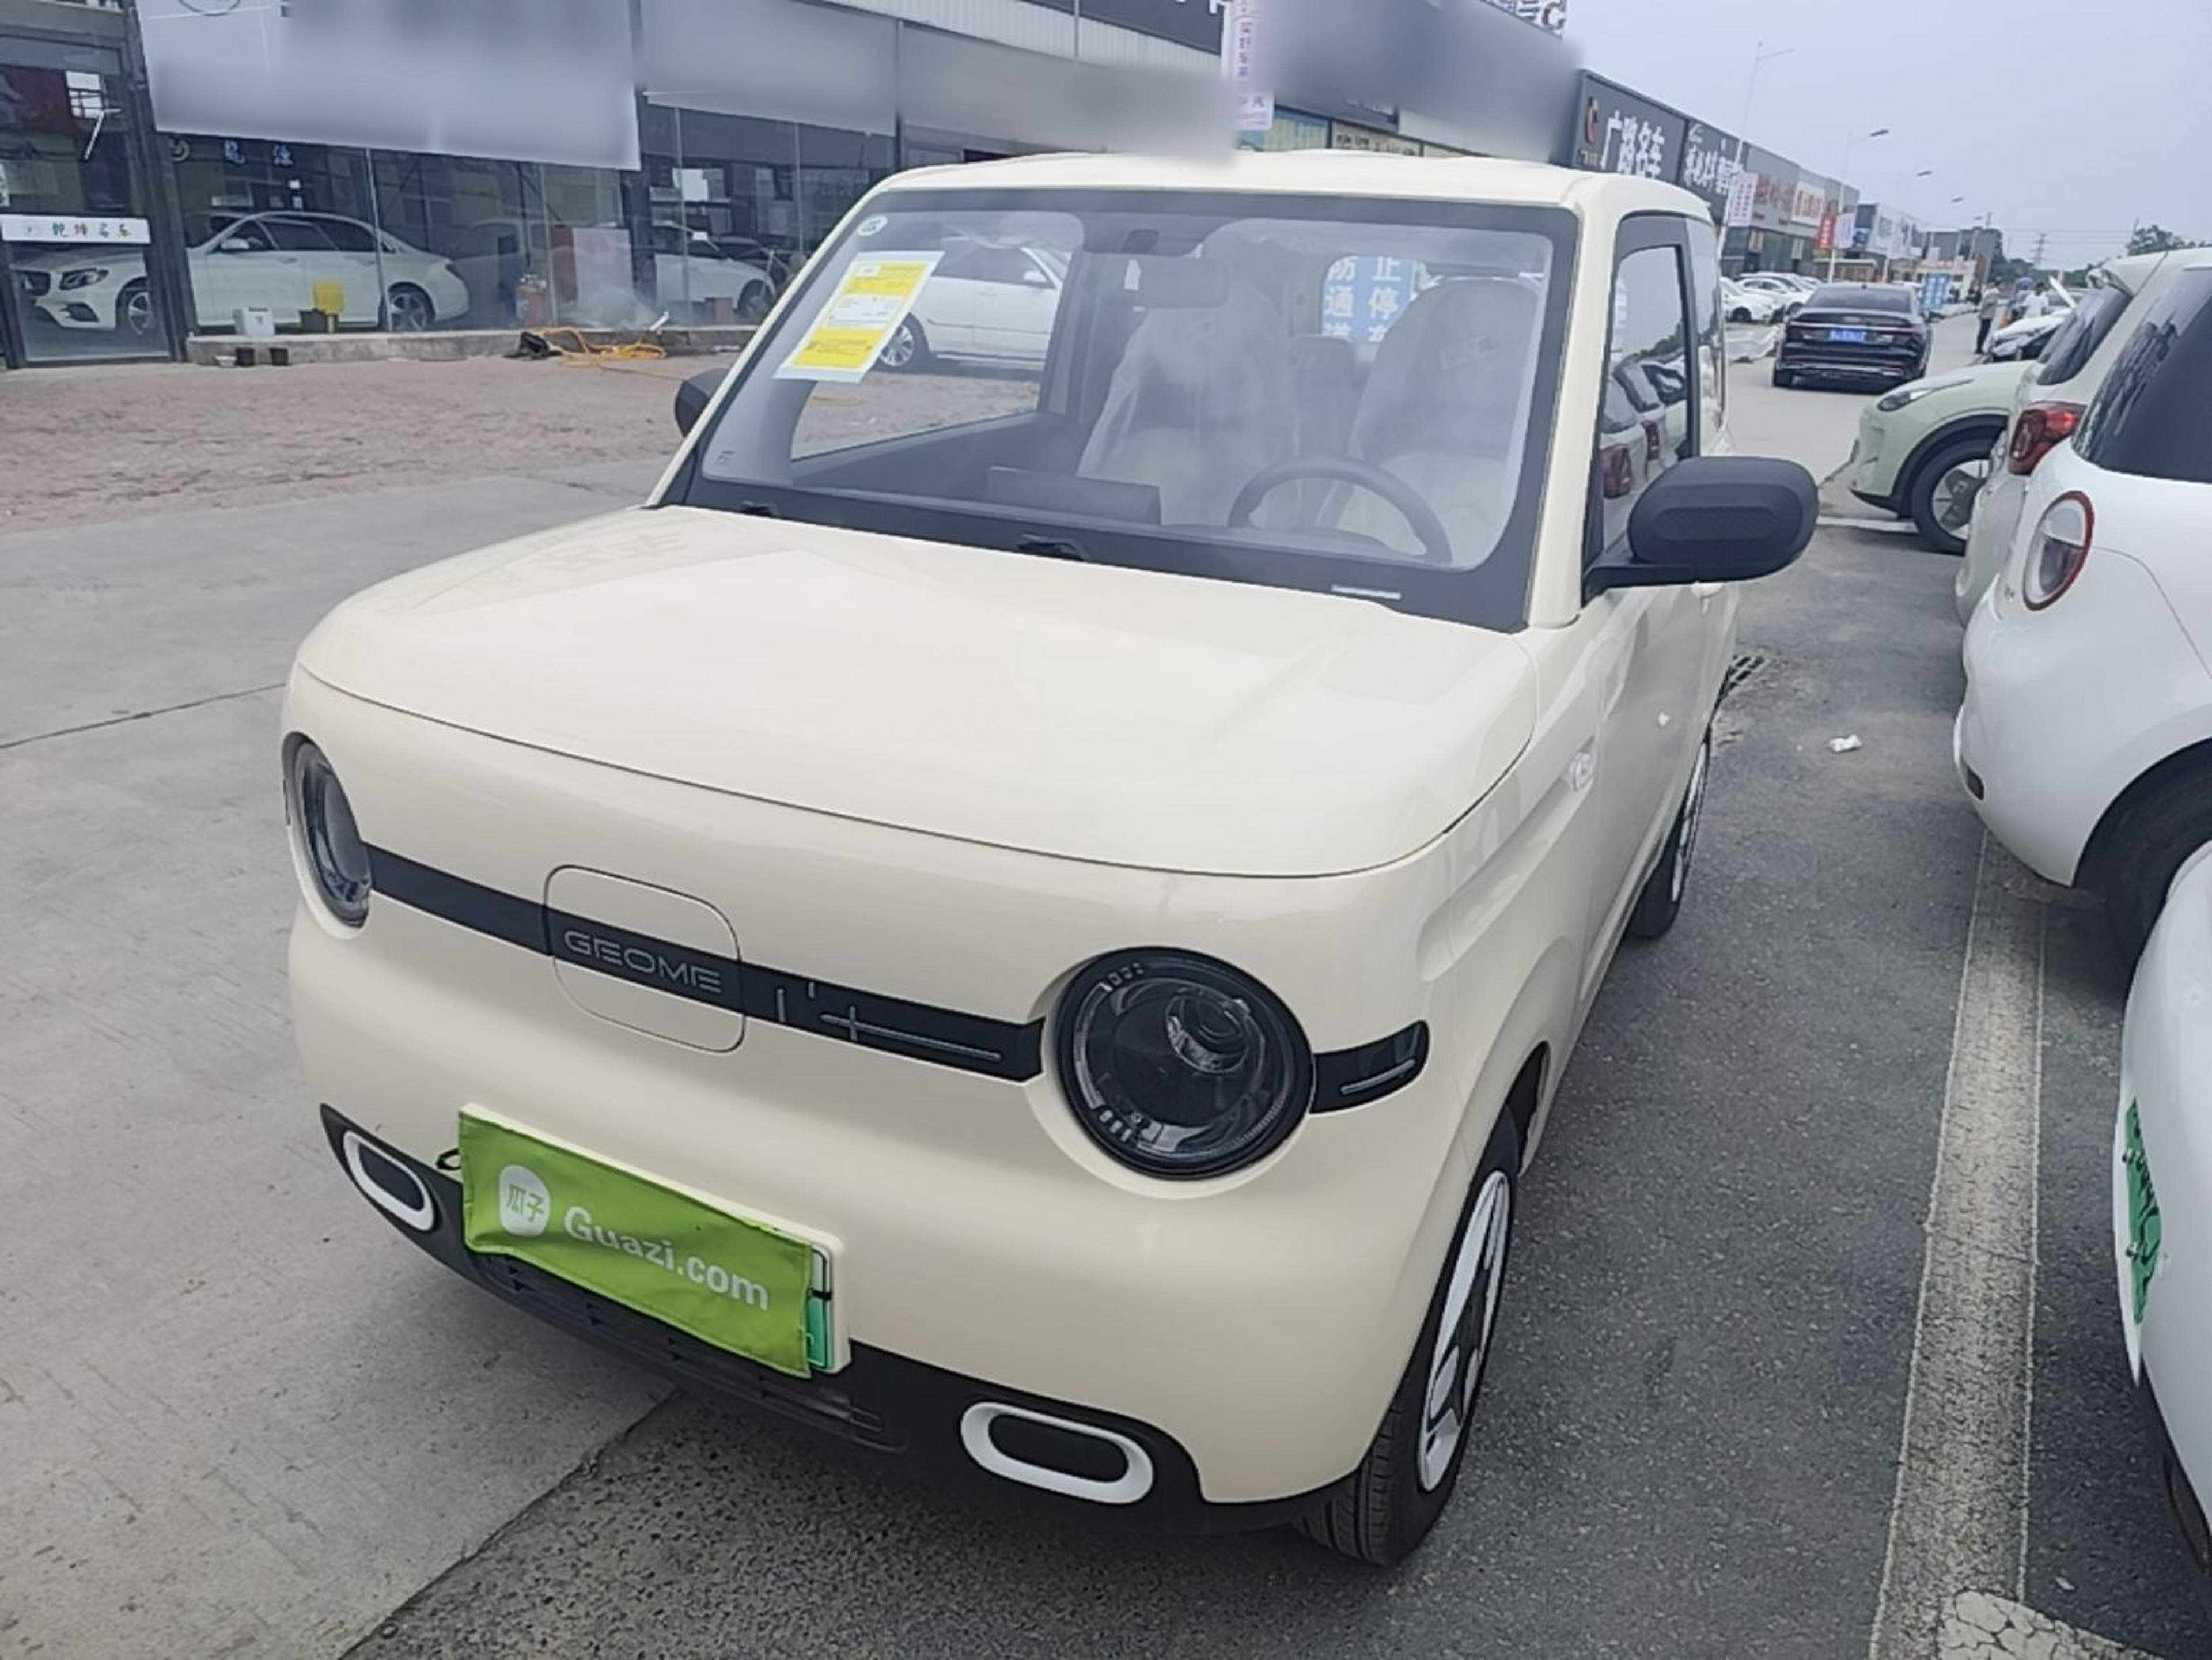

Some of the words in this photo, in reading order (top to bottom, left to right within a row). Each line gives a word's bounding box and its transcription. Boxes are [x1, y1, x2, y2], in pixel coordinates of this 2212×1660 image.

[563, 929, 722, 993] GEOME
[506, 1183, 544, 1222] 瓜子
[564, 1205, 768, 1311] Guazi.com
